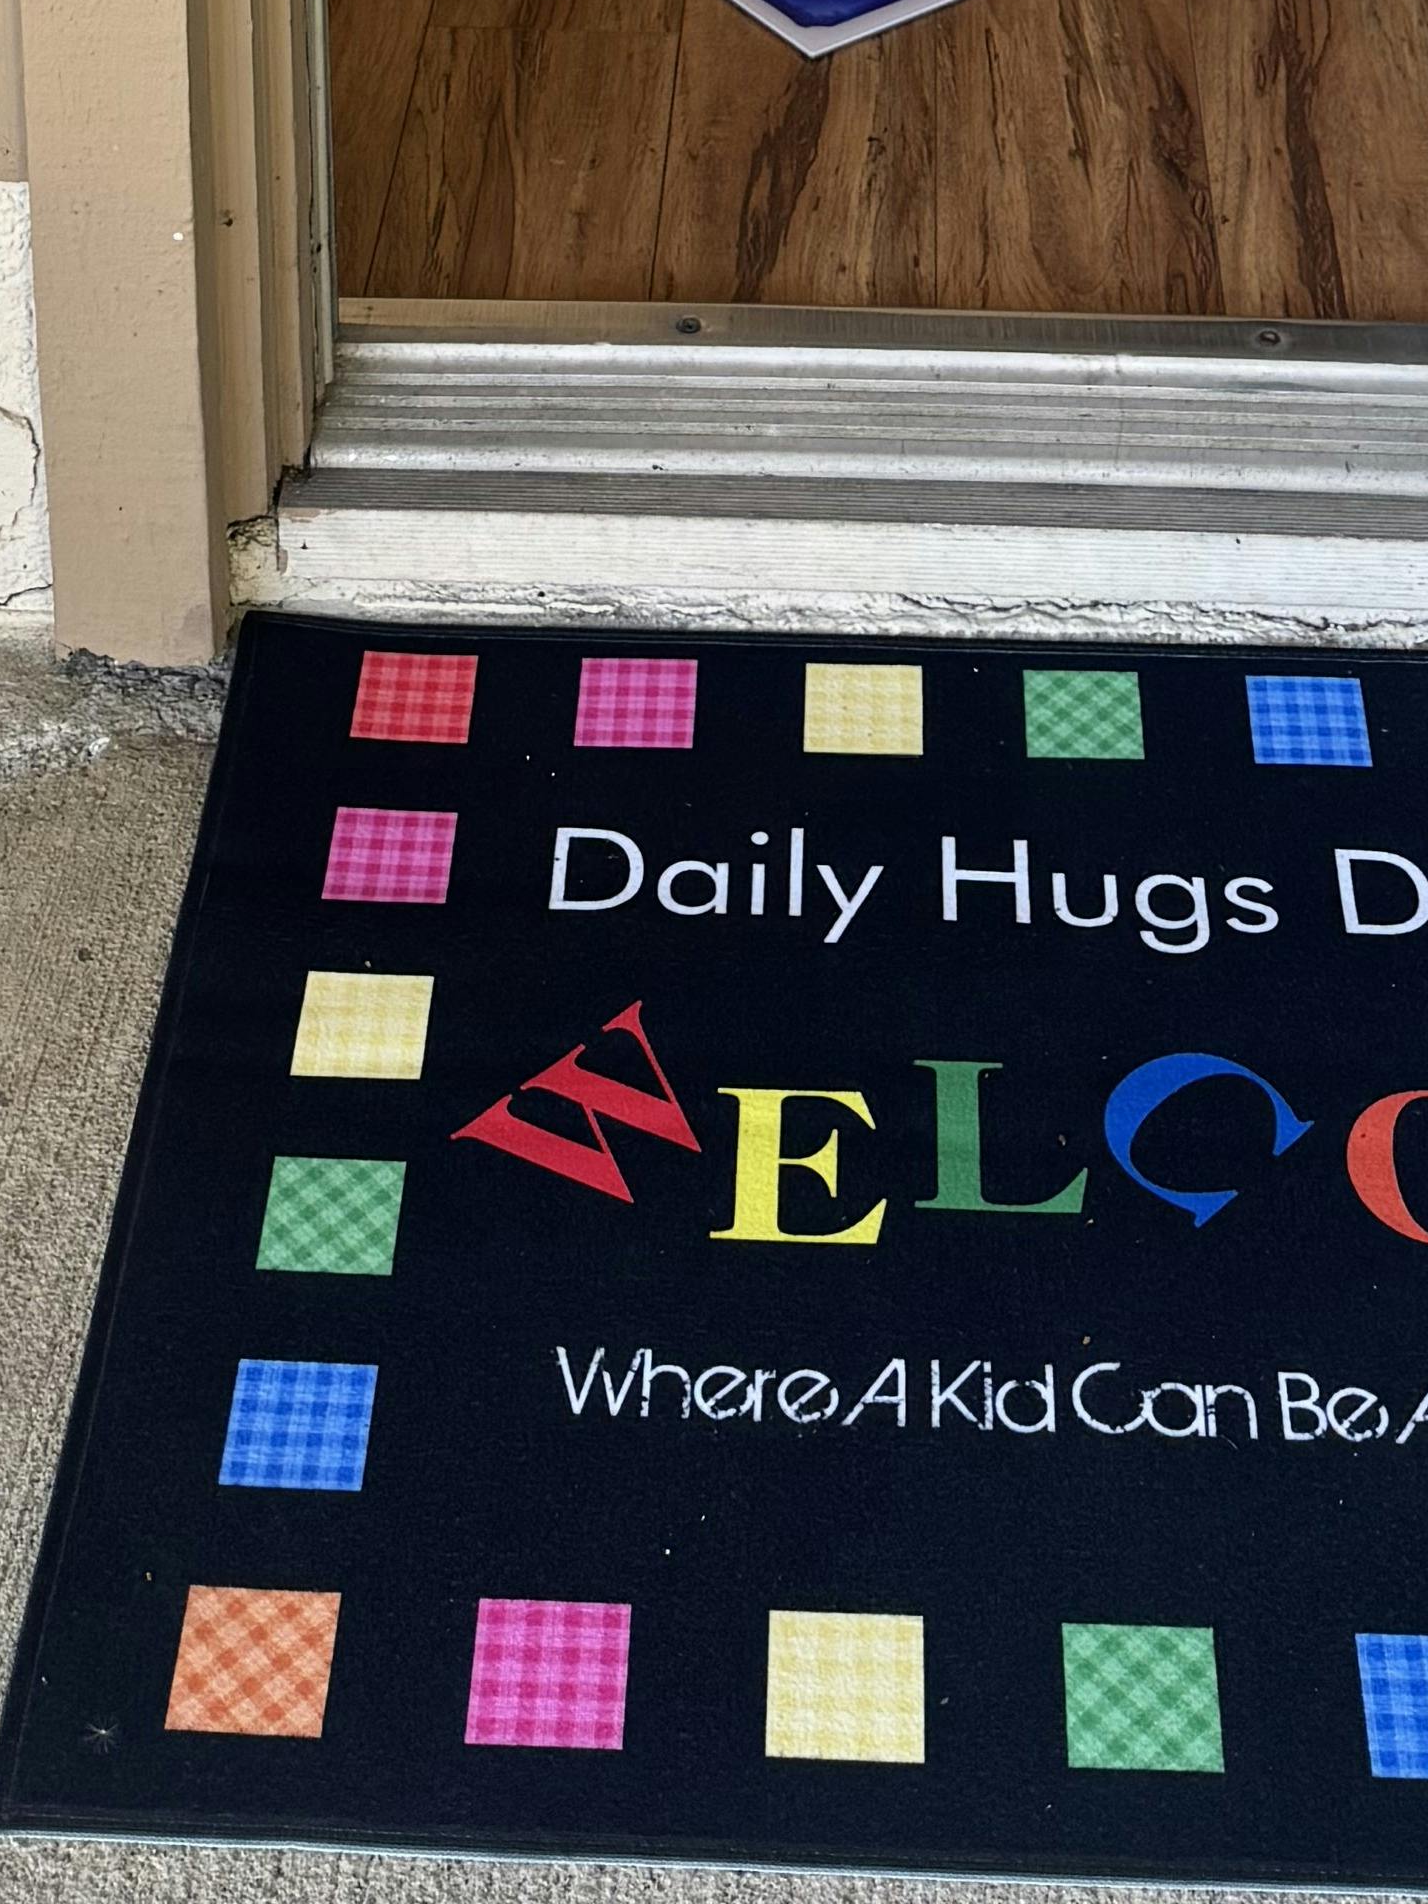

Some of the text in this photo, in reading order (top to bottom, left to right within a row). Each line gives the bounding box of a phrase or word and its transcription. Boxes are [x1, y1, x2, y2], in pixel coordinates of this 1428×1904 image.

[548, 827, 884, 944] Daily
[941, 836, 1279, 954] Hugs
[556, 1346, 839, 1424] Where
[842, 1358, 907, 1427] A
[930, 1359, 1056, 1434] Kid
[1071, 1362, 1258, 1440] Can
[1277, 1371, 1389, 1442] Be
